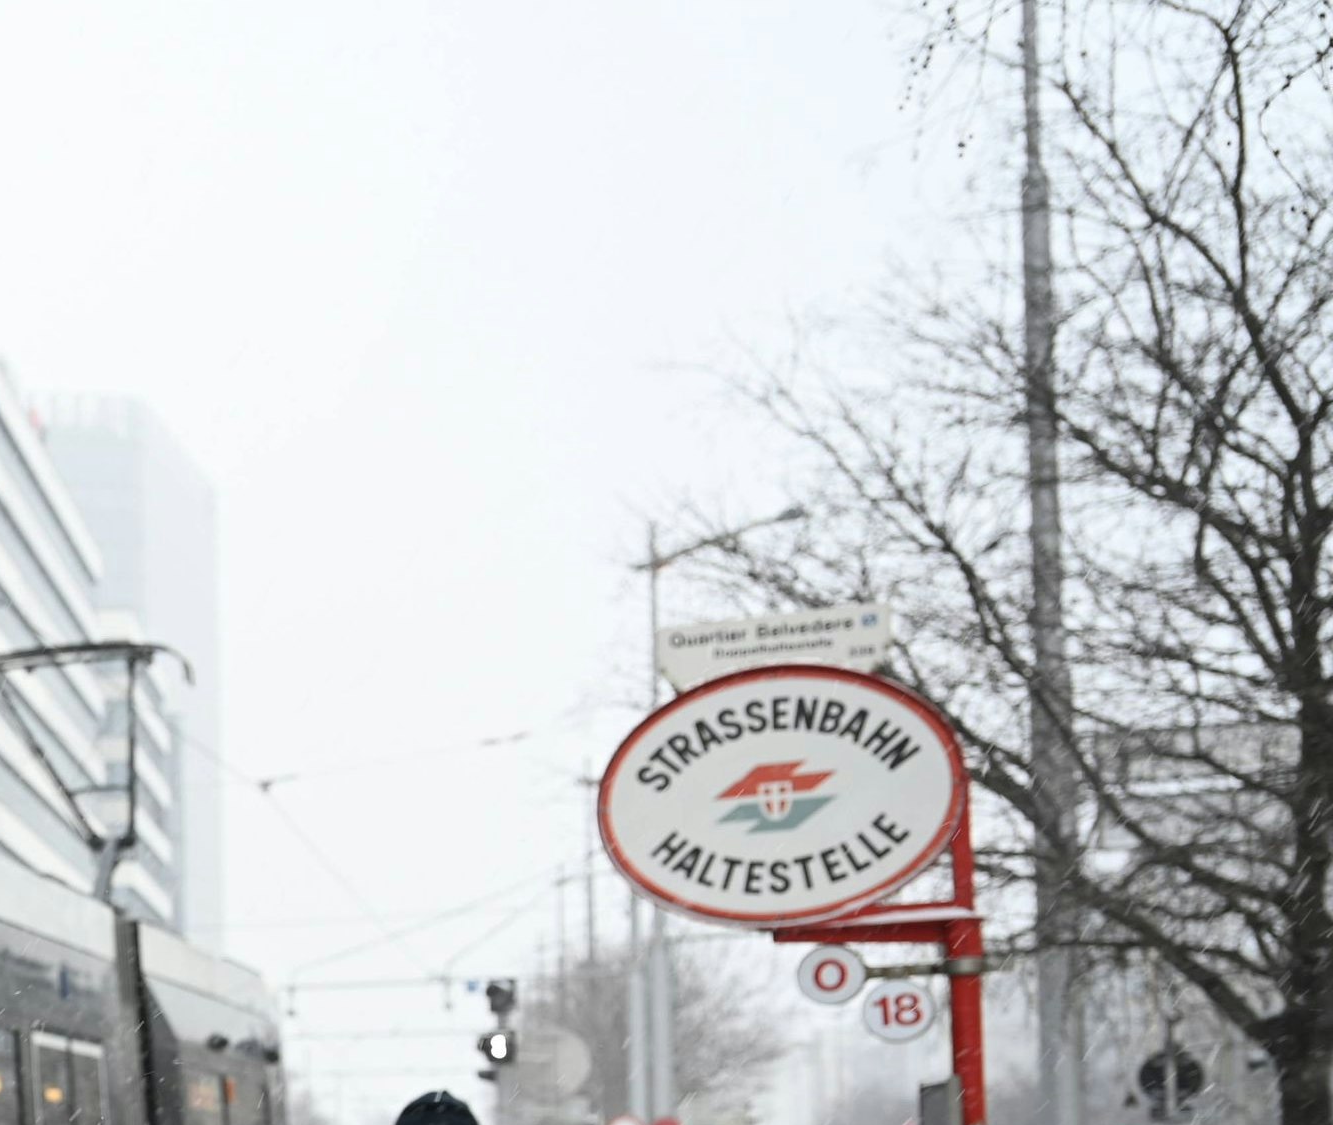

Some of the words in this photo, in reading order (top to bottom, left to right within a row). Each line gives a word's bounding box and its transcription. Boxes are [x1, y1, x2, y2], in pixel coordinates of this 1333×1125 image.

[668, 628, 746, 649] Quartier
[756, 616, 854, 639] Belvedere
[635, 695, 921, 793] STRASSENBAHN
[651, 812, 912, 895] HALTESTELLE
[873, 992, 924, 1027] 18
